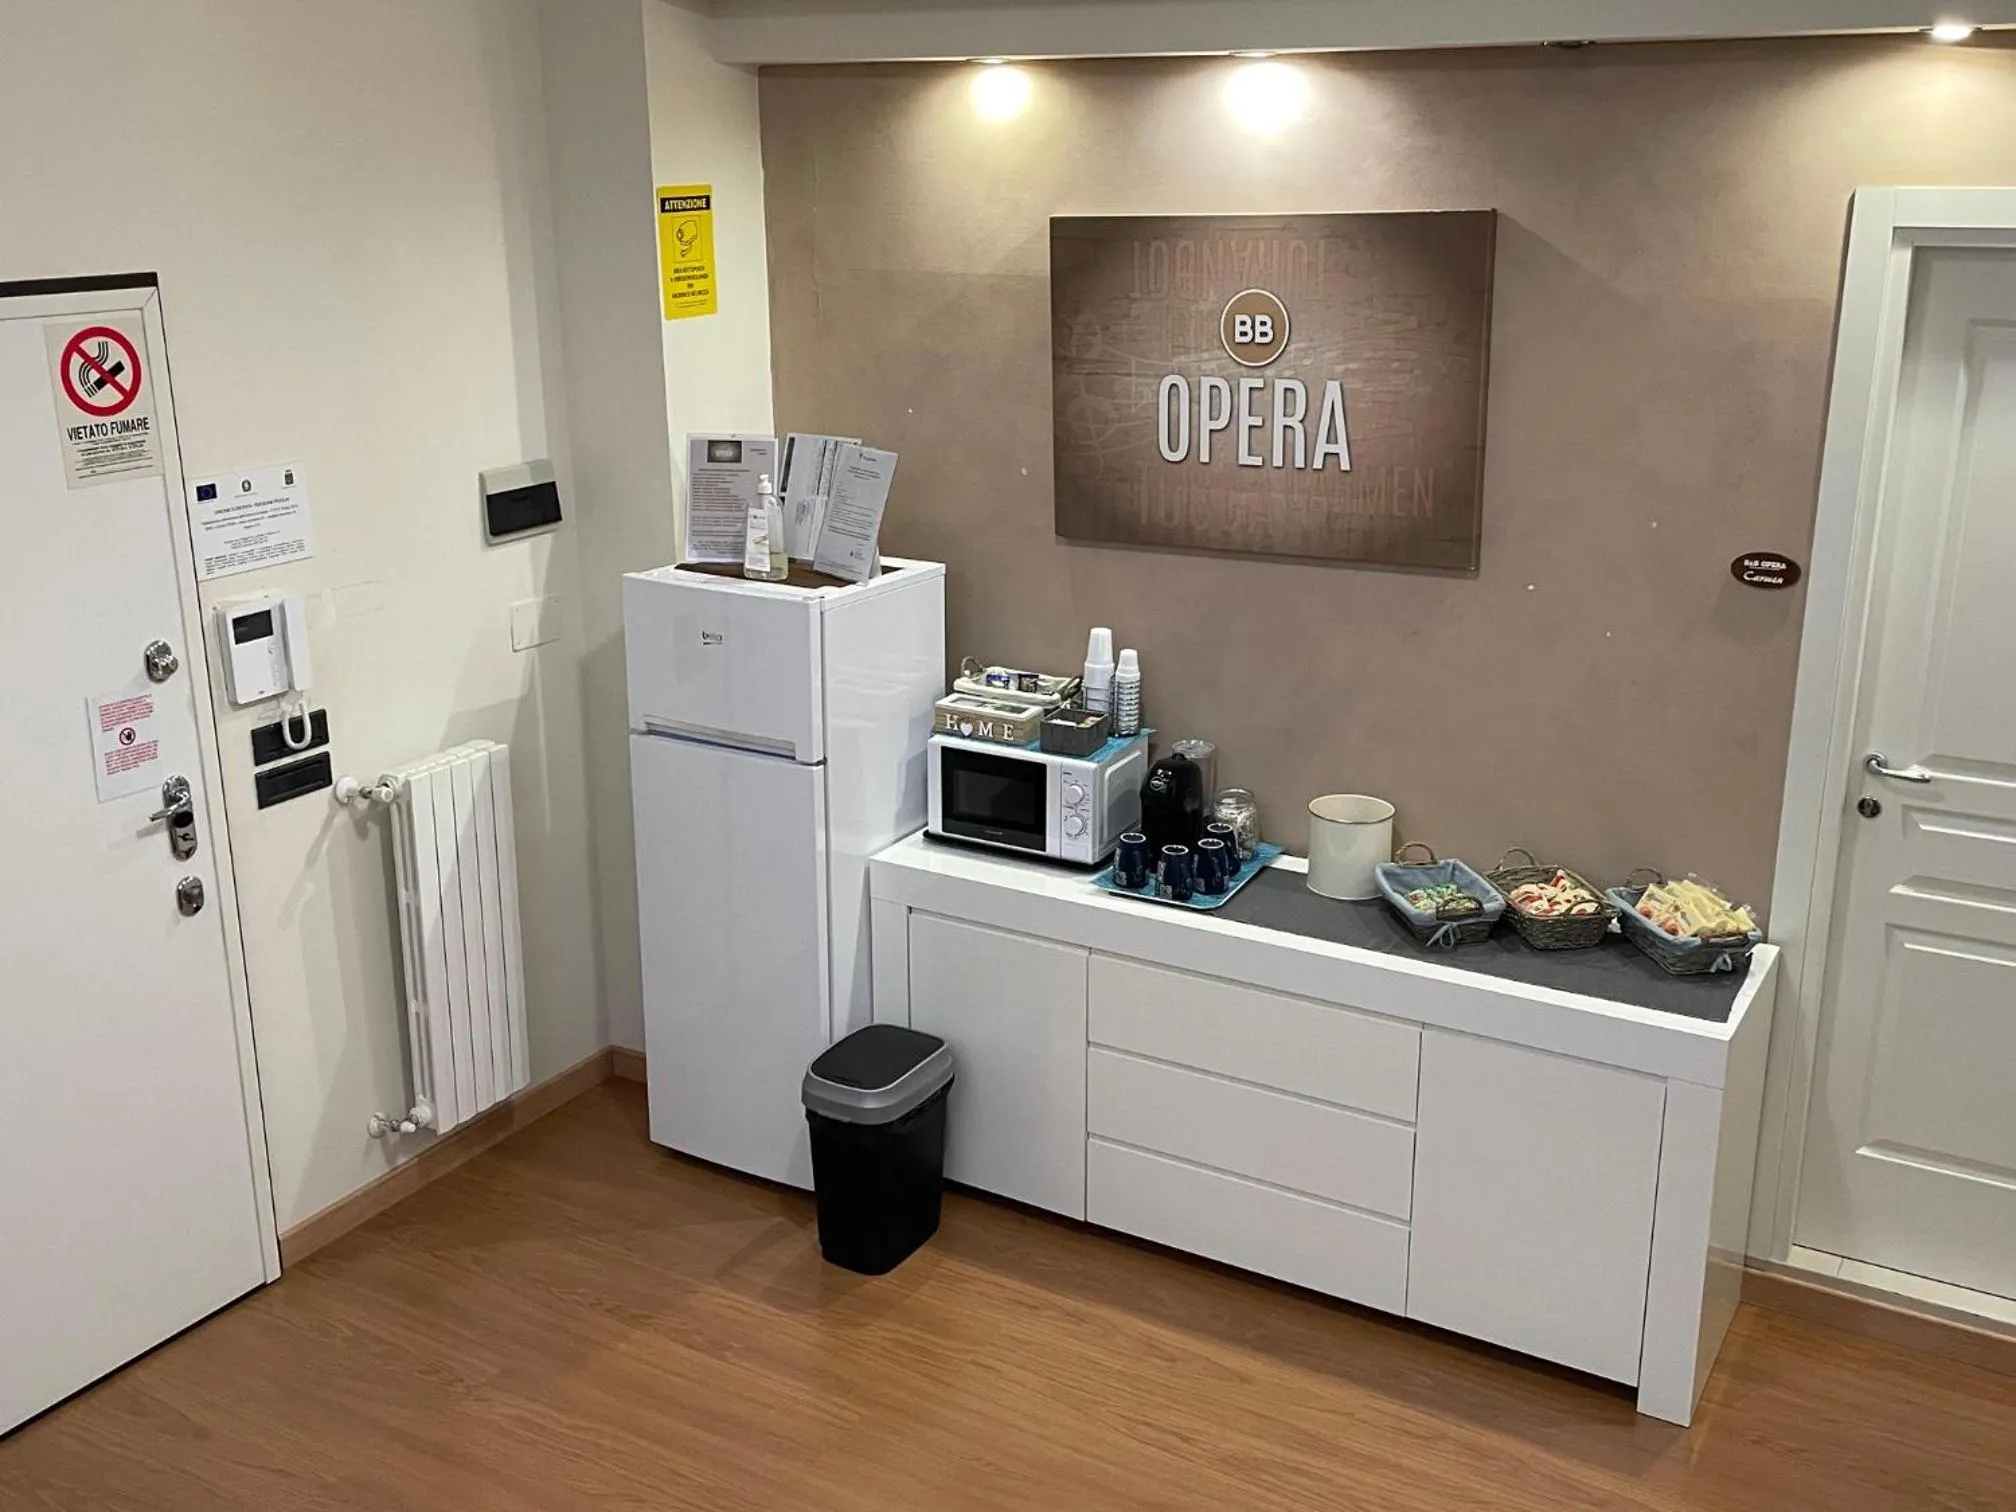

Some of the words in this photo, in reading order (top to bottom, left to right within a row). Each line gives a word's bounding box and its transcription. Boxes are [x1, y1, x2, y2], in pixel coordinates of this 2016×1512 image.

[664, 198, 708, 211] ATTENZIONE
[1234, 313, 1275, 345] BB
[66, 422, 108, 441] VIETATO
[110, 417, 150, 435] FUMARE
[1157, 373, 1352, 473] OPERA
[1760, 560, 1787, 570] OPERA
